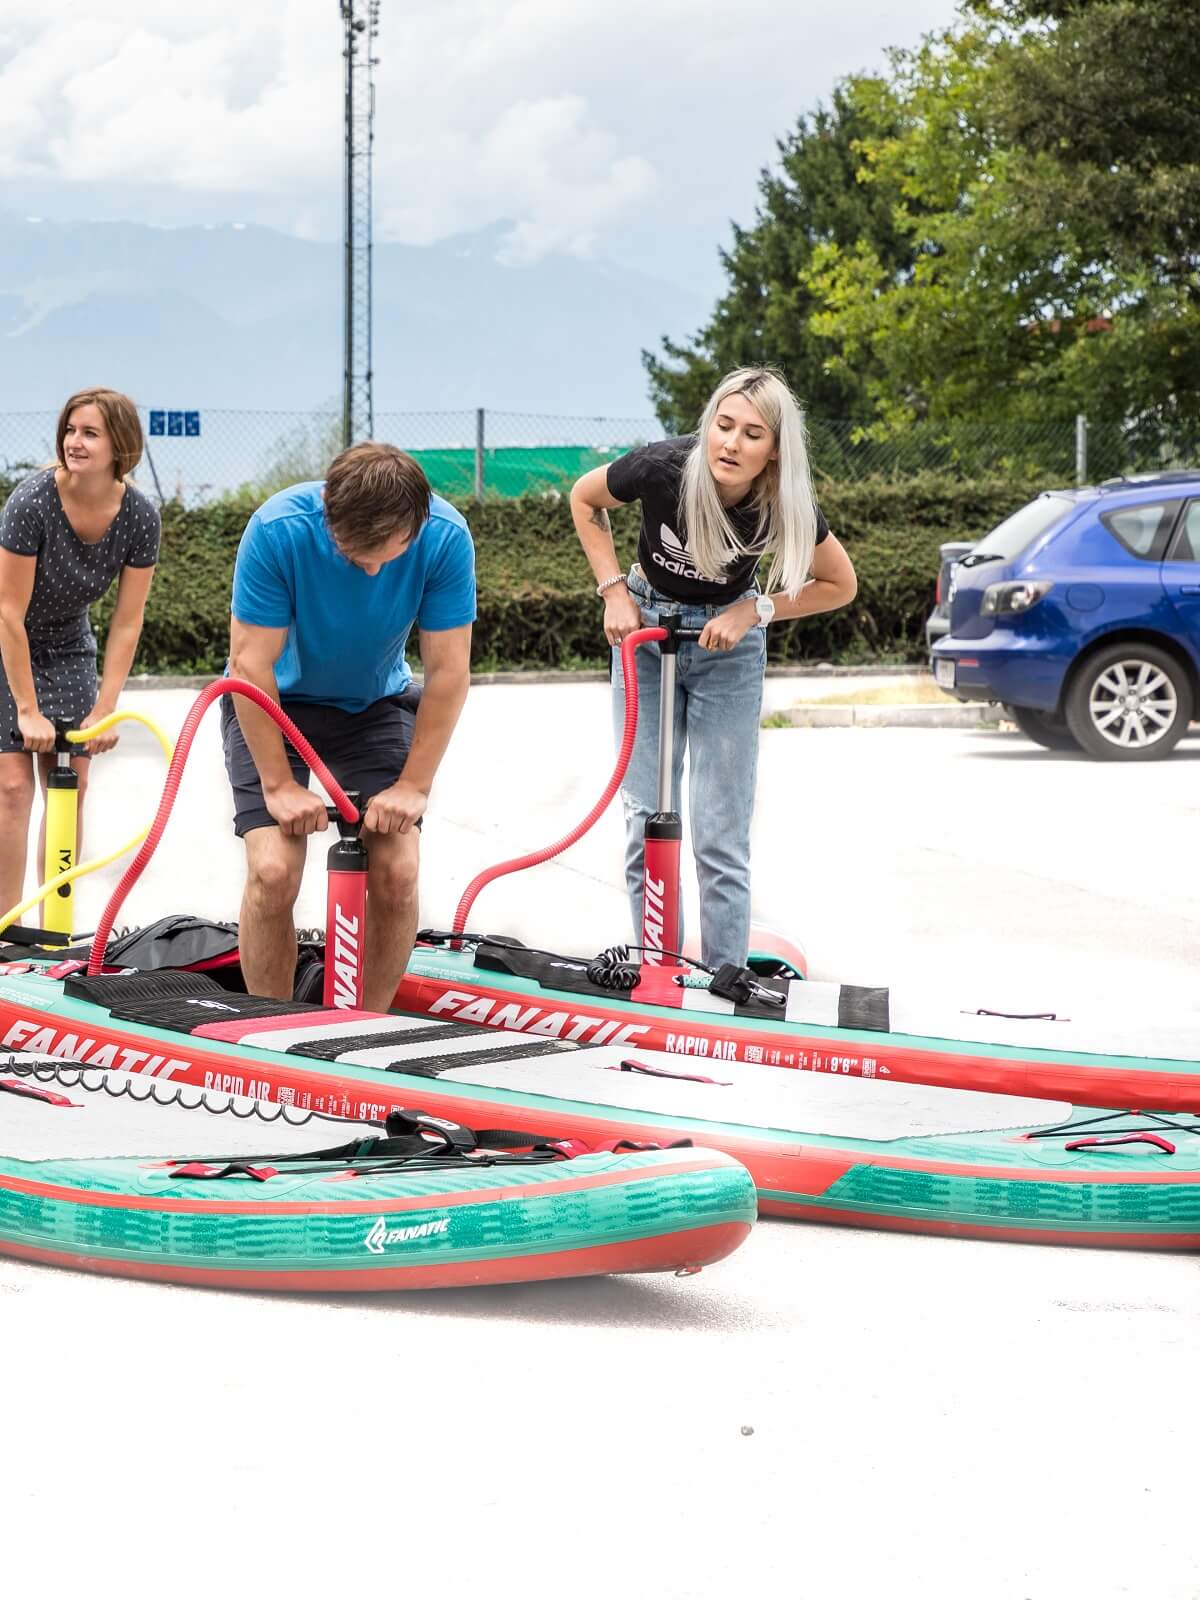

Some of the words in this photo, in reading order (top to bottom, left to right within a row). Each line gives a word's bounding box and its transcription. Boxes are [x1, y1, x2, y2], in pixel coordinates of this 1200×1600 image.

[644, 867, 665, 967] NATIC
[334, 903, 359, 1010] NATIC
[428, 990, 651, 1048] FANATIC
[665, 1033, 709, 1057] RAPID
[712, 1039, 738, 1061] AIR
[204, 1071, 244, 1097] RAPID
[248, 1079, 271, 1101] AIR
[385, 1217, 452, 1245] FANATIC
